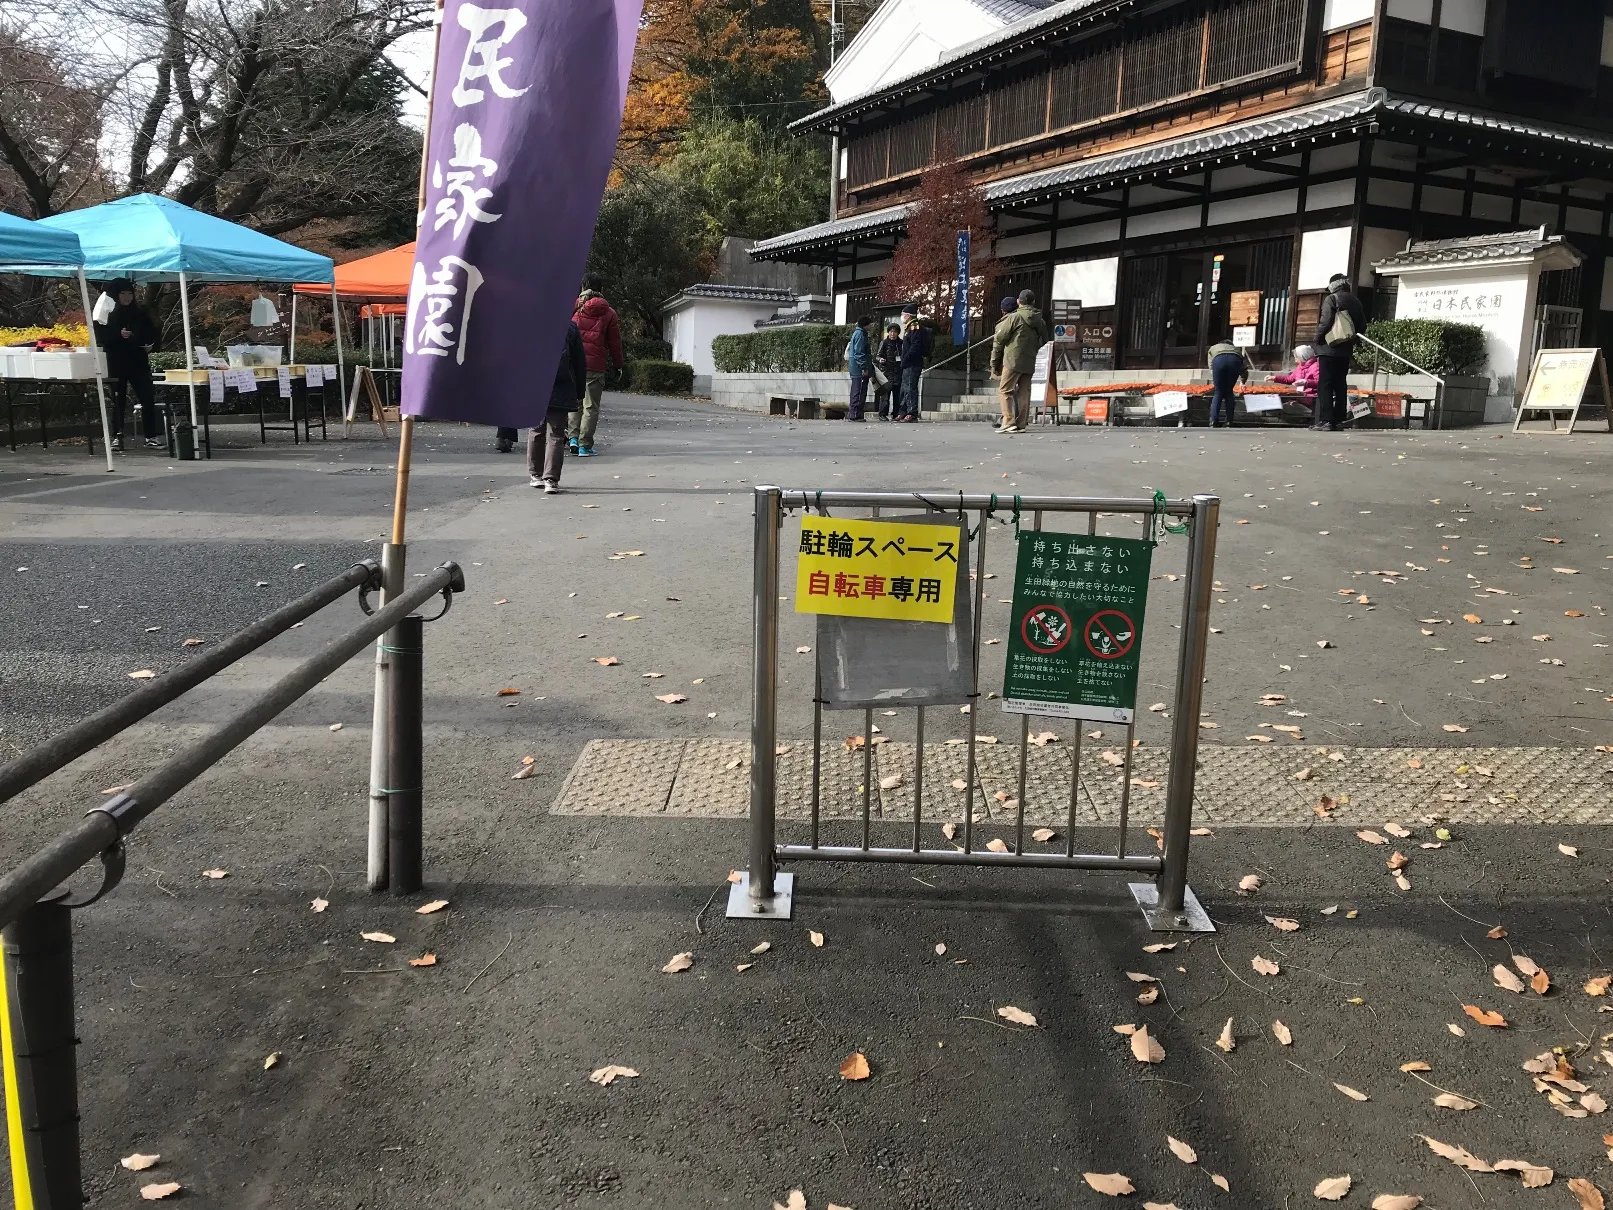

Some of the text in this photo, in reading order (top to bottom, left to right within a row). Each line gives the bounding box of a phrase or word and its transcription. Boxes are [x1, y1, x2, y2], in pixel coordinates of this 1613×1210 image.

[405, 2, 533, 366] 民家園
[1432, 293, 1503, 311] 日本民家園
[1083, 327, 1100, 336] 入口
[799, 529, 958, 563] 駐輪スペース
[1033, 539, 1131, 558] 持ち出さない
[1031, 556, 1129, 574] 持ち込まない
[808, 572, 942, 603] 自転車専用
[1024, 576, 1136, 593] 生田緑地の自然を守るために
[1023, 588, 1135, 604] みんなで協力したい大切なこと
